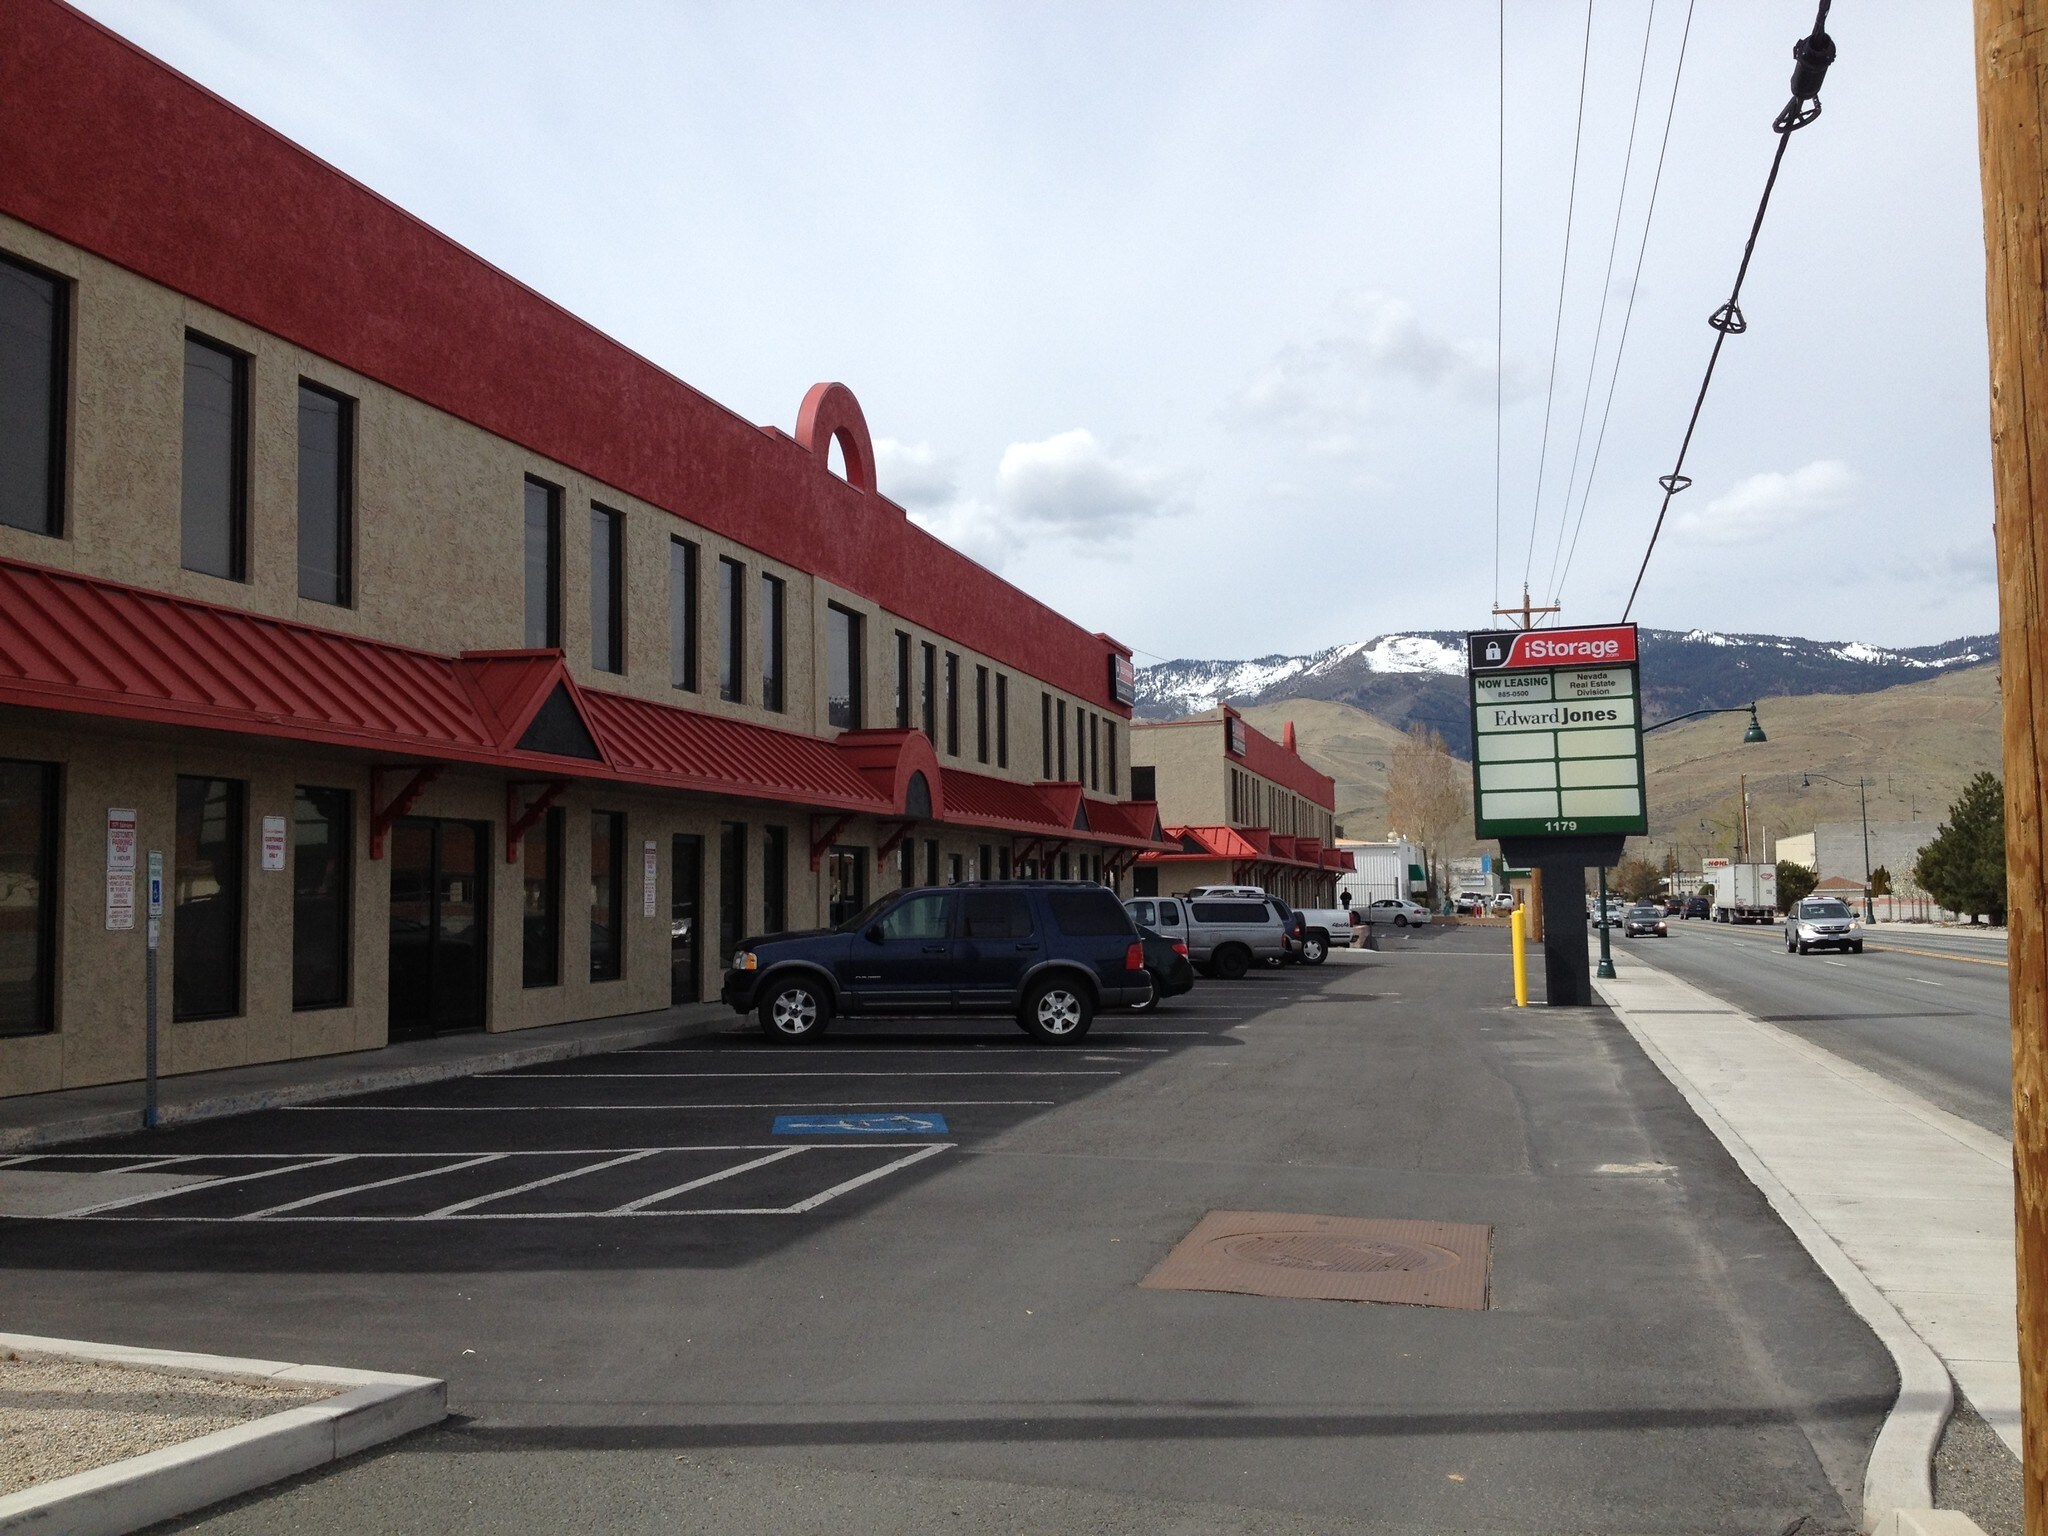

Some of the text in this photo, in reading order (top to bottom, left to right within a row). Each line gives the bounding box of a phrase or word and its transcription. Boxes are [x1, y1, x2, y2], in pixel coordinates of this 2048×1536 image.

[1525, 640, 1618, 659] iStorage
[1576, 672, 1608, 681] Nevada
[1478, 676, 1549, 689] NOW LEASING
[1569, 679, 1616, 689] Real Estate
[1498, 690, 1529, 698] 885-0500
[1576, 688, 1610, 697] Division
[1494, 707, 1618, 726] Edward Jones
[1545, 821, 1577, 832] 1179
